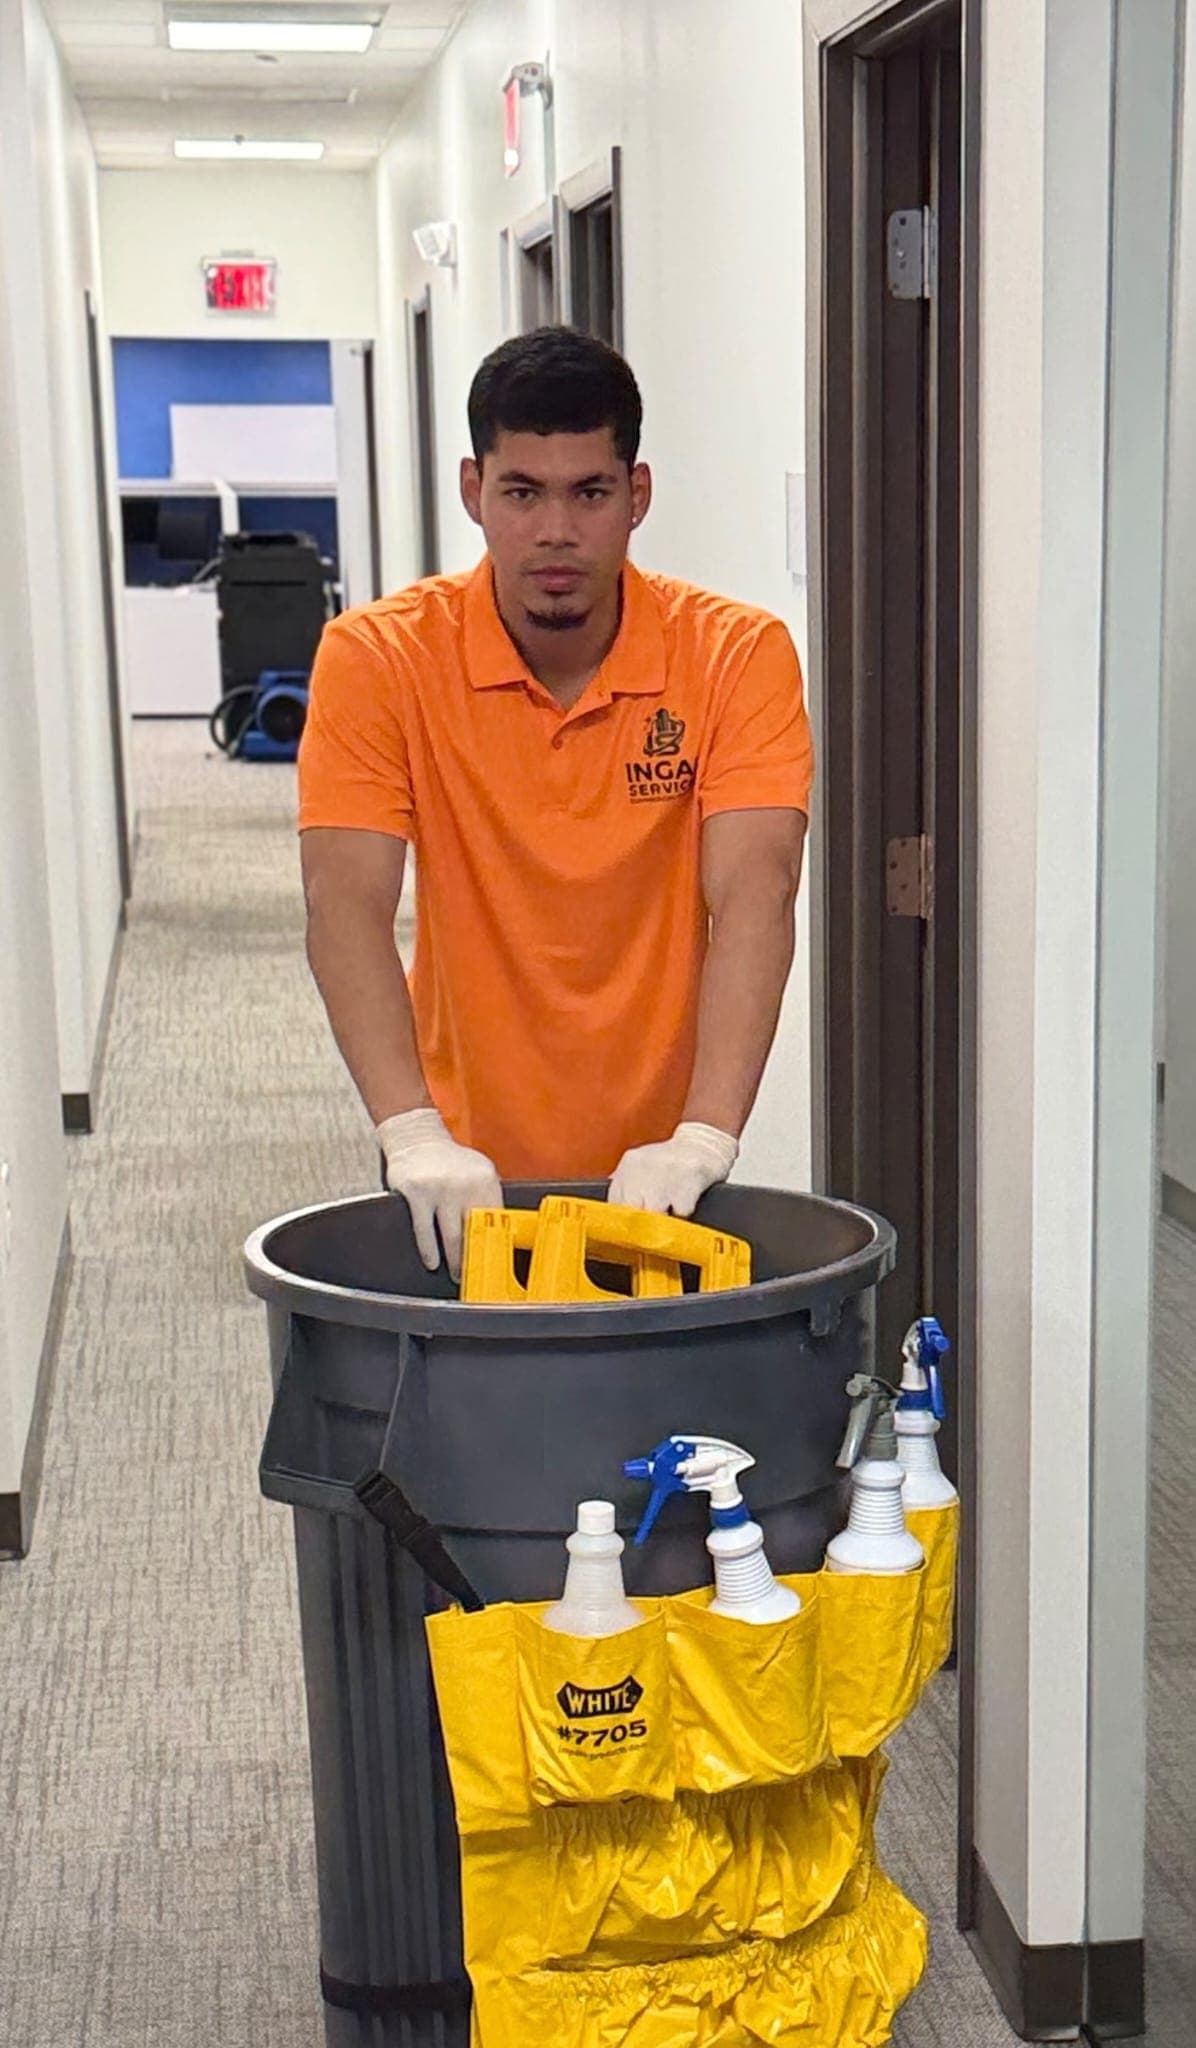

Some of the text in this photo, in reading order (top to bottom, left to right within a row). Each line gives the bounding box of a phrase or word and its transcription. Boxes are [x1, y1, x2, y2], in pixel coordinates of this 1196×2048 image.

[625, 759, 694, 783] INGA
[565, 1680, 632, 1714] WHITE
[557, 1719, 647, 1747] #7705
